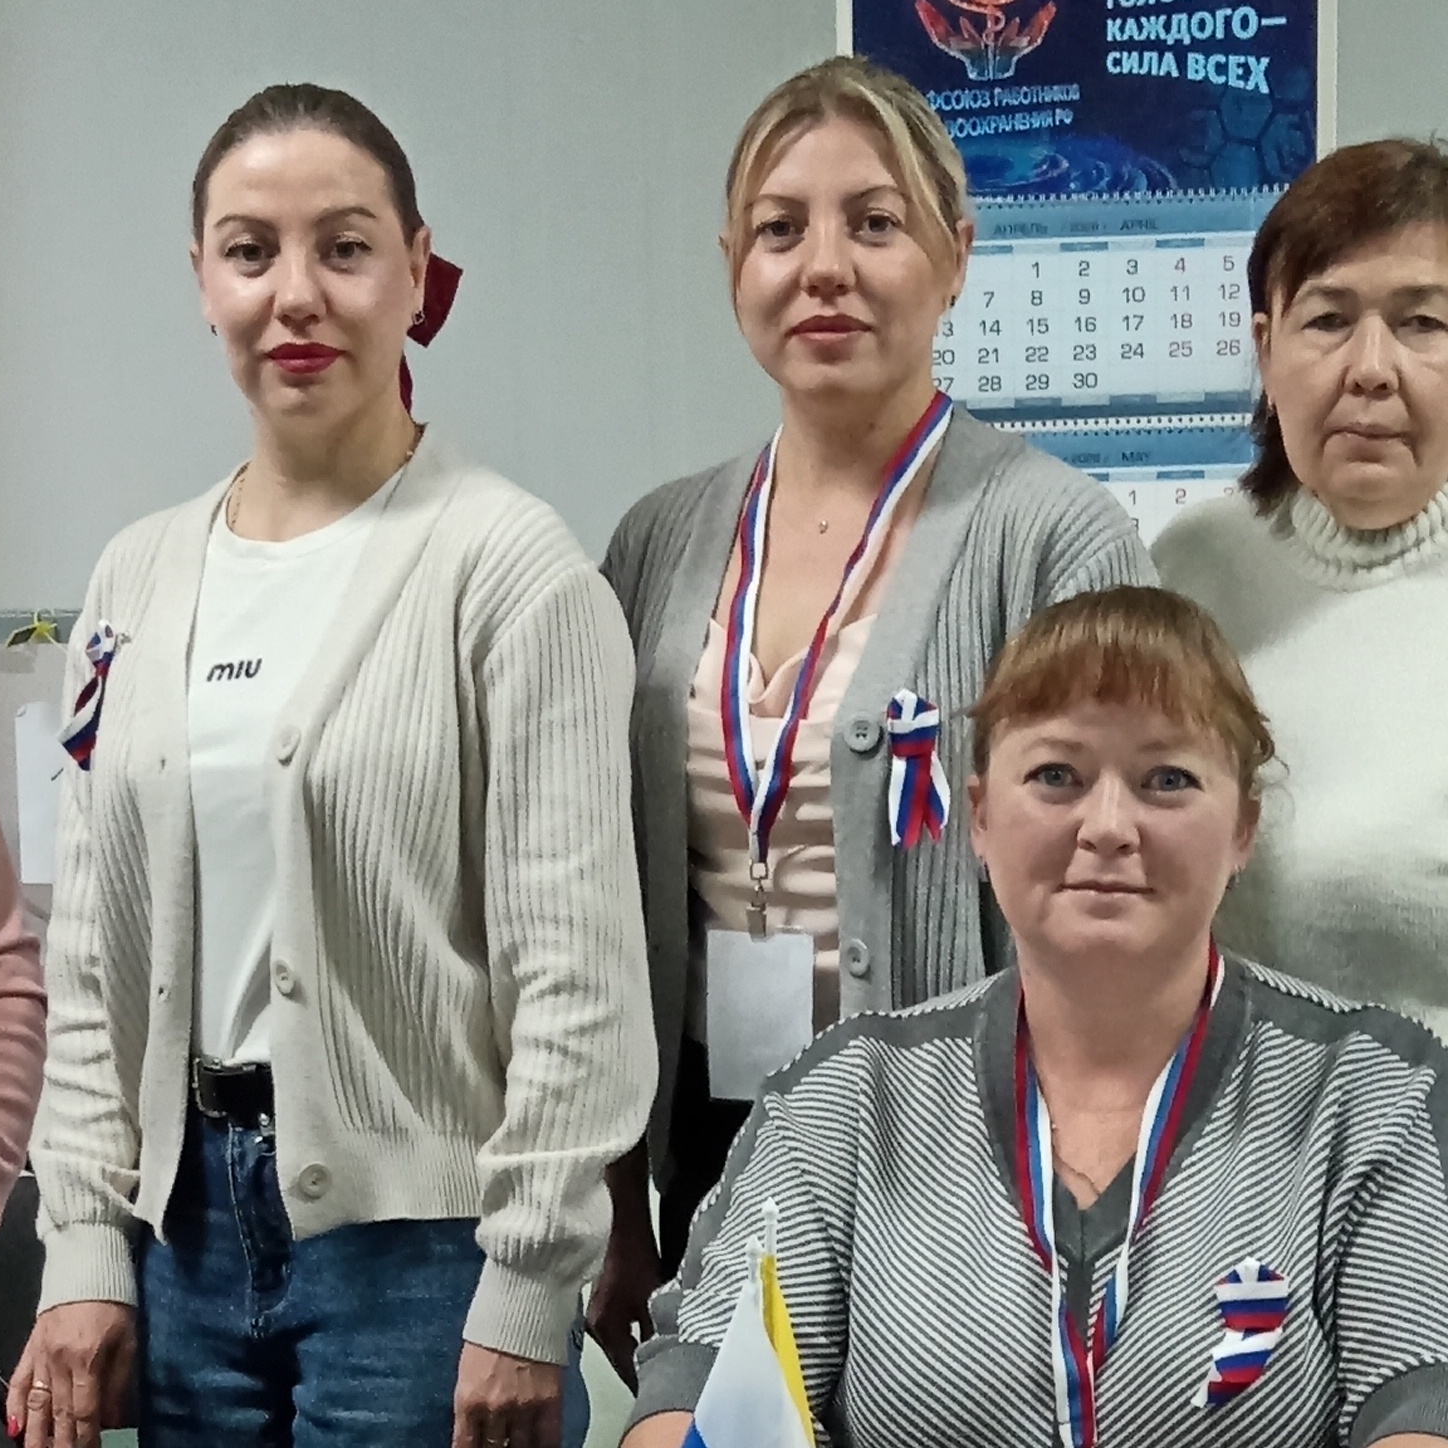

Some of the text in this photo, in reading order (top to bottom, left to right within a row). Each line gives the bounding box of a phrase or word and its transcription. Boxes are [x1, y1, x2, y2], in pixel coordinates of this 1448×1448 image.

[1106, 51, 1270, 94] СИЛА ВСЕХ
[1031, 254, 1236, 279] 1 2 3 4 5
[983, 283, 1242, 309] 7 8 9 10 11 12
[979, 319, 1002, 337] 14
[1026, 317, 1050, 336] 15
[1074, 316, 1097, 334] 16
[1122, 314, 1145, 332] 17
[1170, 313, 1193, 330] 18
[1218, 311, 1242, 328] 19
[932, 338, 1241, 366] 20 21 22 23 24 25 26
[977, 375, 1002, 393] 28
[1025, 373, 1050, 391] 29
[1072, 372, 1098, 390] 30
[1127, 487, 1188, 506] 1 2
